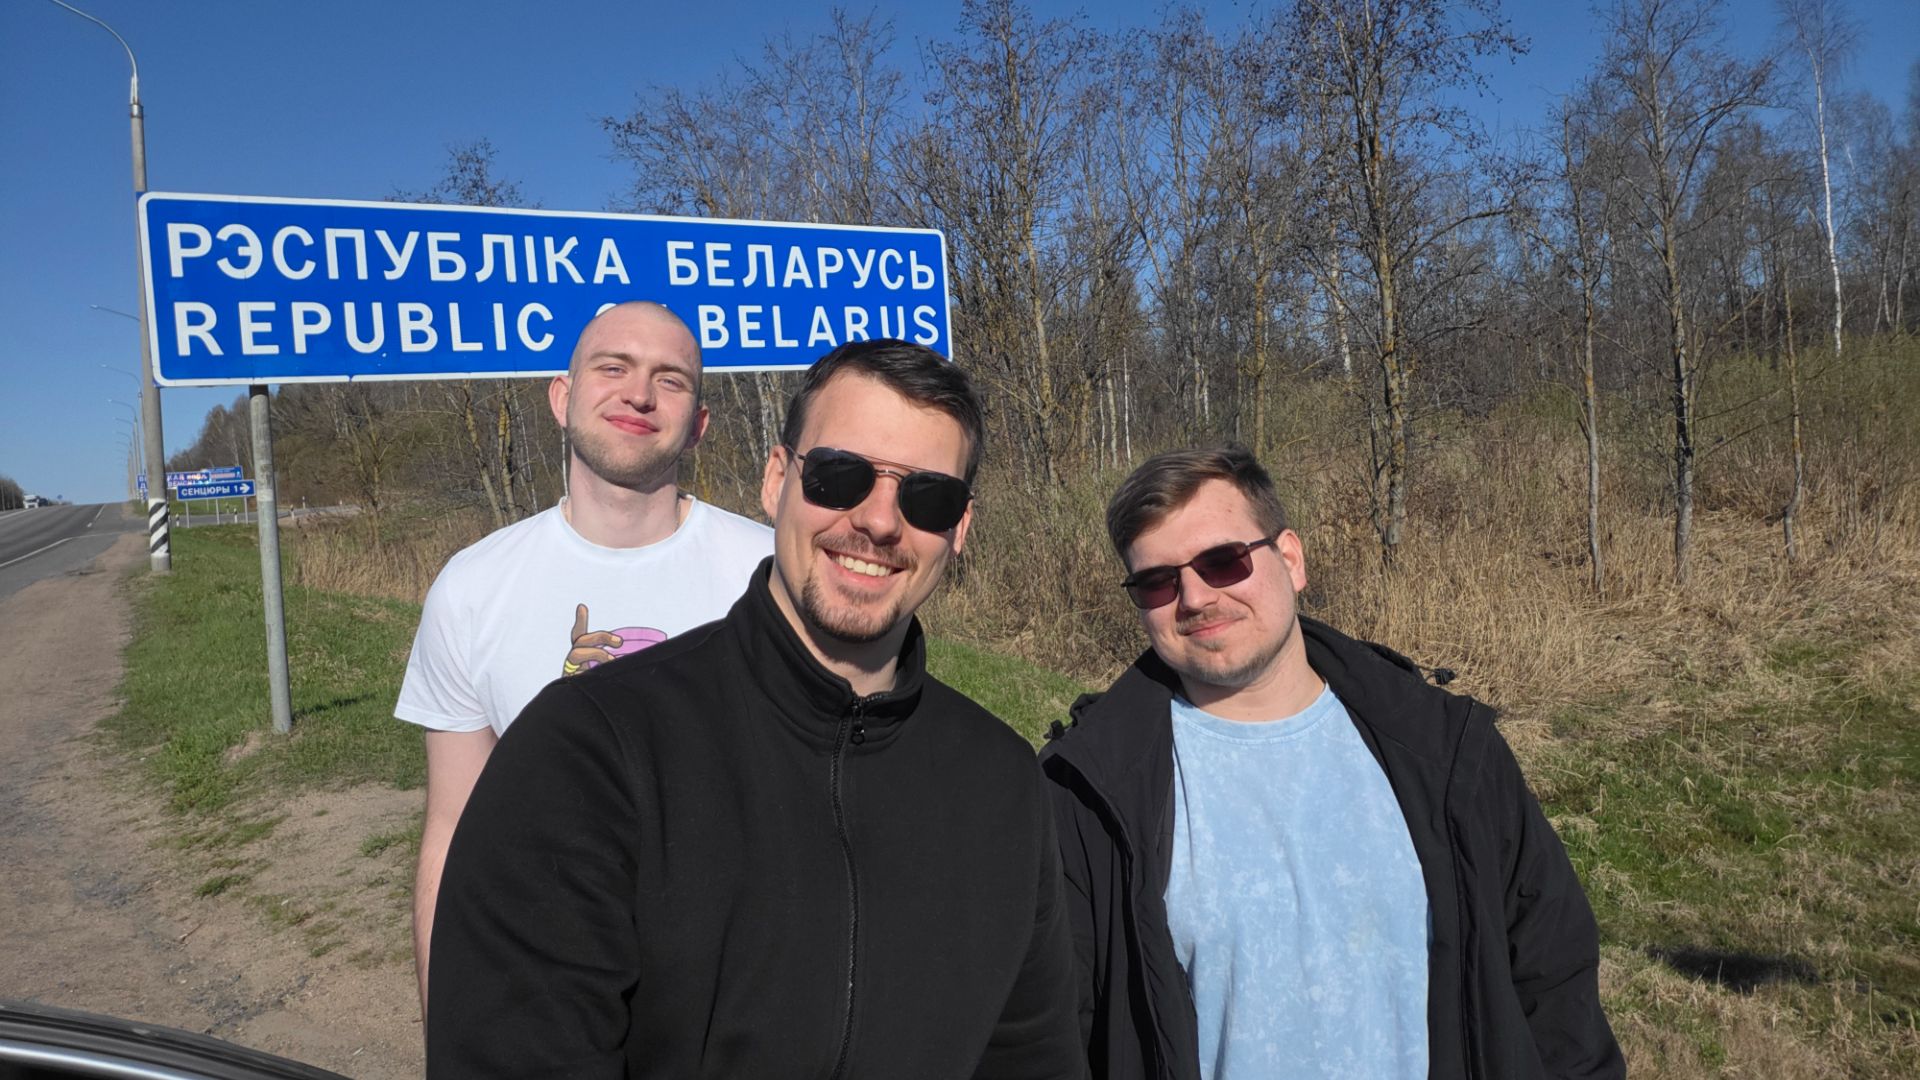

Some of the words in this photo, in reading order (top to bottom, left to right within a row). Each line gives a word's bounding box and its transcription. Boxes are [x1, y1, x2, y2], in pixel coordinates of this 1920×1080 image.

[166, 222, 631, 285] РЭСПУБЛІКА
[666, 240, 936, 290] БЕЛАРУСЬ
[173, 301, 555, 356] REPUBLIC
[697, 304, 940, 348] BELARUS
[181, 486, 230, 496] СЕНЦЮРЫ
